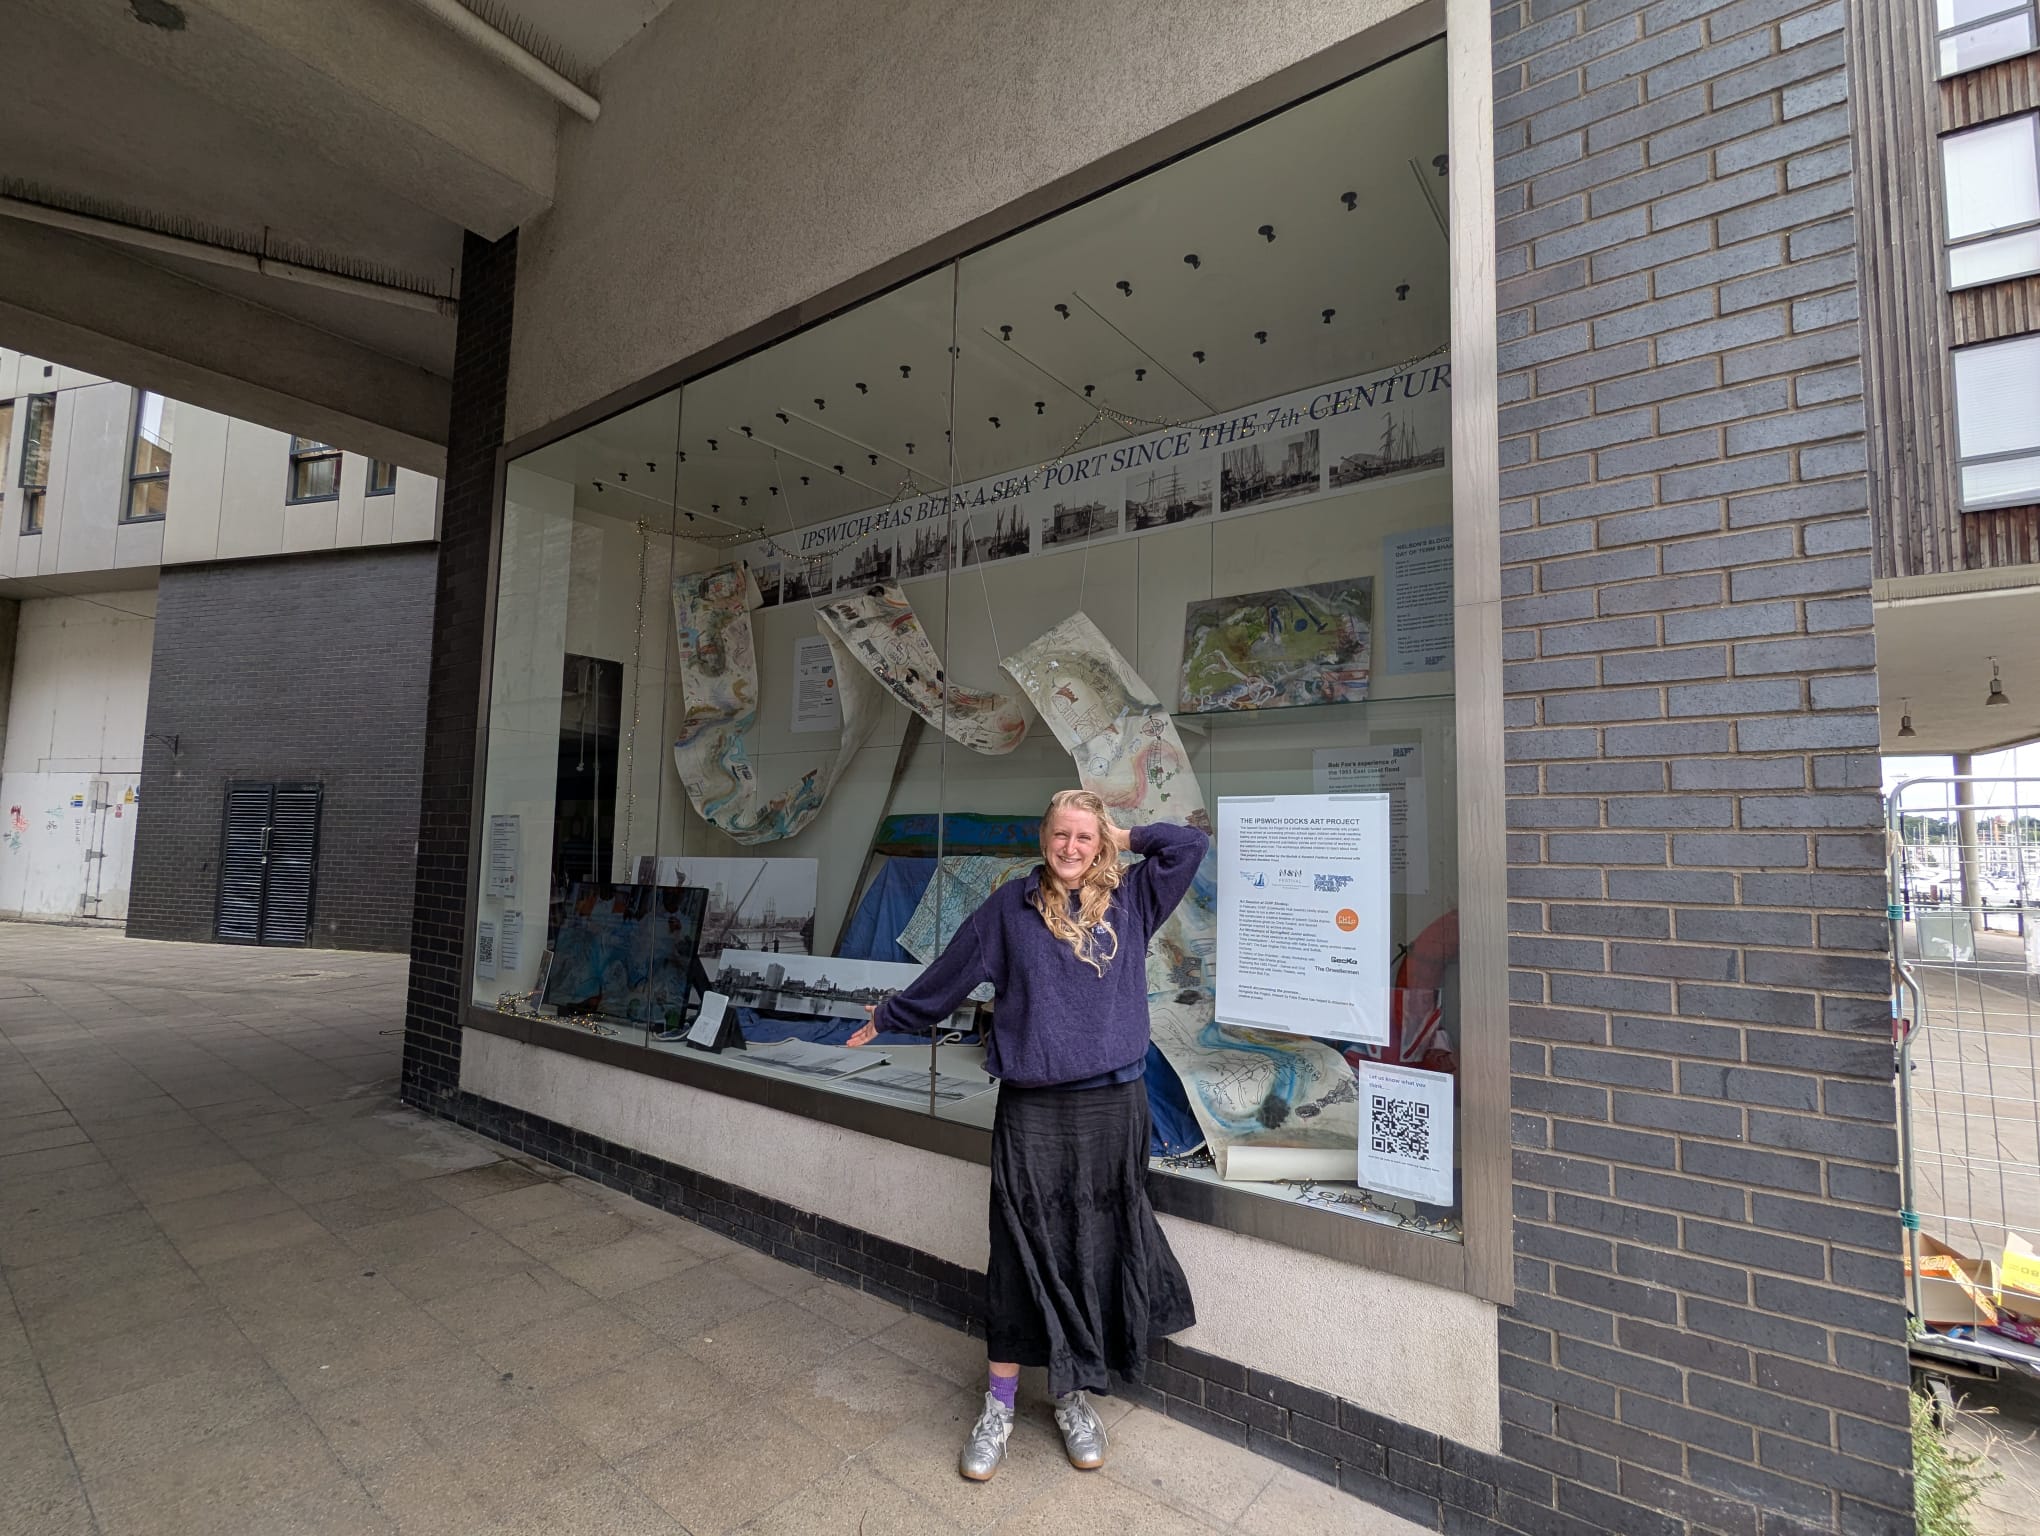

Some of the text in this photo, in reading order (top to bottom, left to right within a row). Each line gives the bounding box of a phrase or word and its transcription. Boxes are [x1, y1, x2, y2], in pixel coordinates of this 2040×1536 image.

[800, 516, 872, 550] IPSWICH
[876, 507, 912, 530] HAS
[916, 491, 966, 521] BEEN
[971, 486, 986, 508] A
[991, 473, 1032, 504] SEA
[1043, 454, 1108, 490] PORT
[1111, 432, 1193, 473] SINCE
[1198, 413, 1258, 450] THE
[1267, 406, 1301, 432] 7th
[1357, 759, 1389, 768] experience
[1254, 817, 1282, 825] IPSWICH
[1401, 1078, 1415, 1087] what
